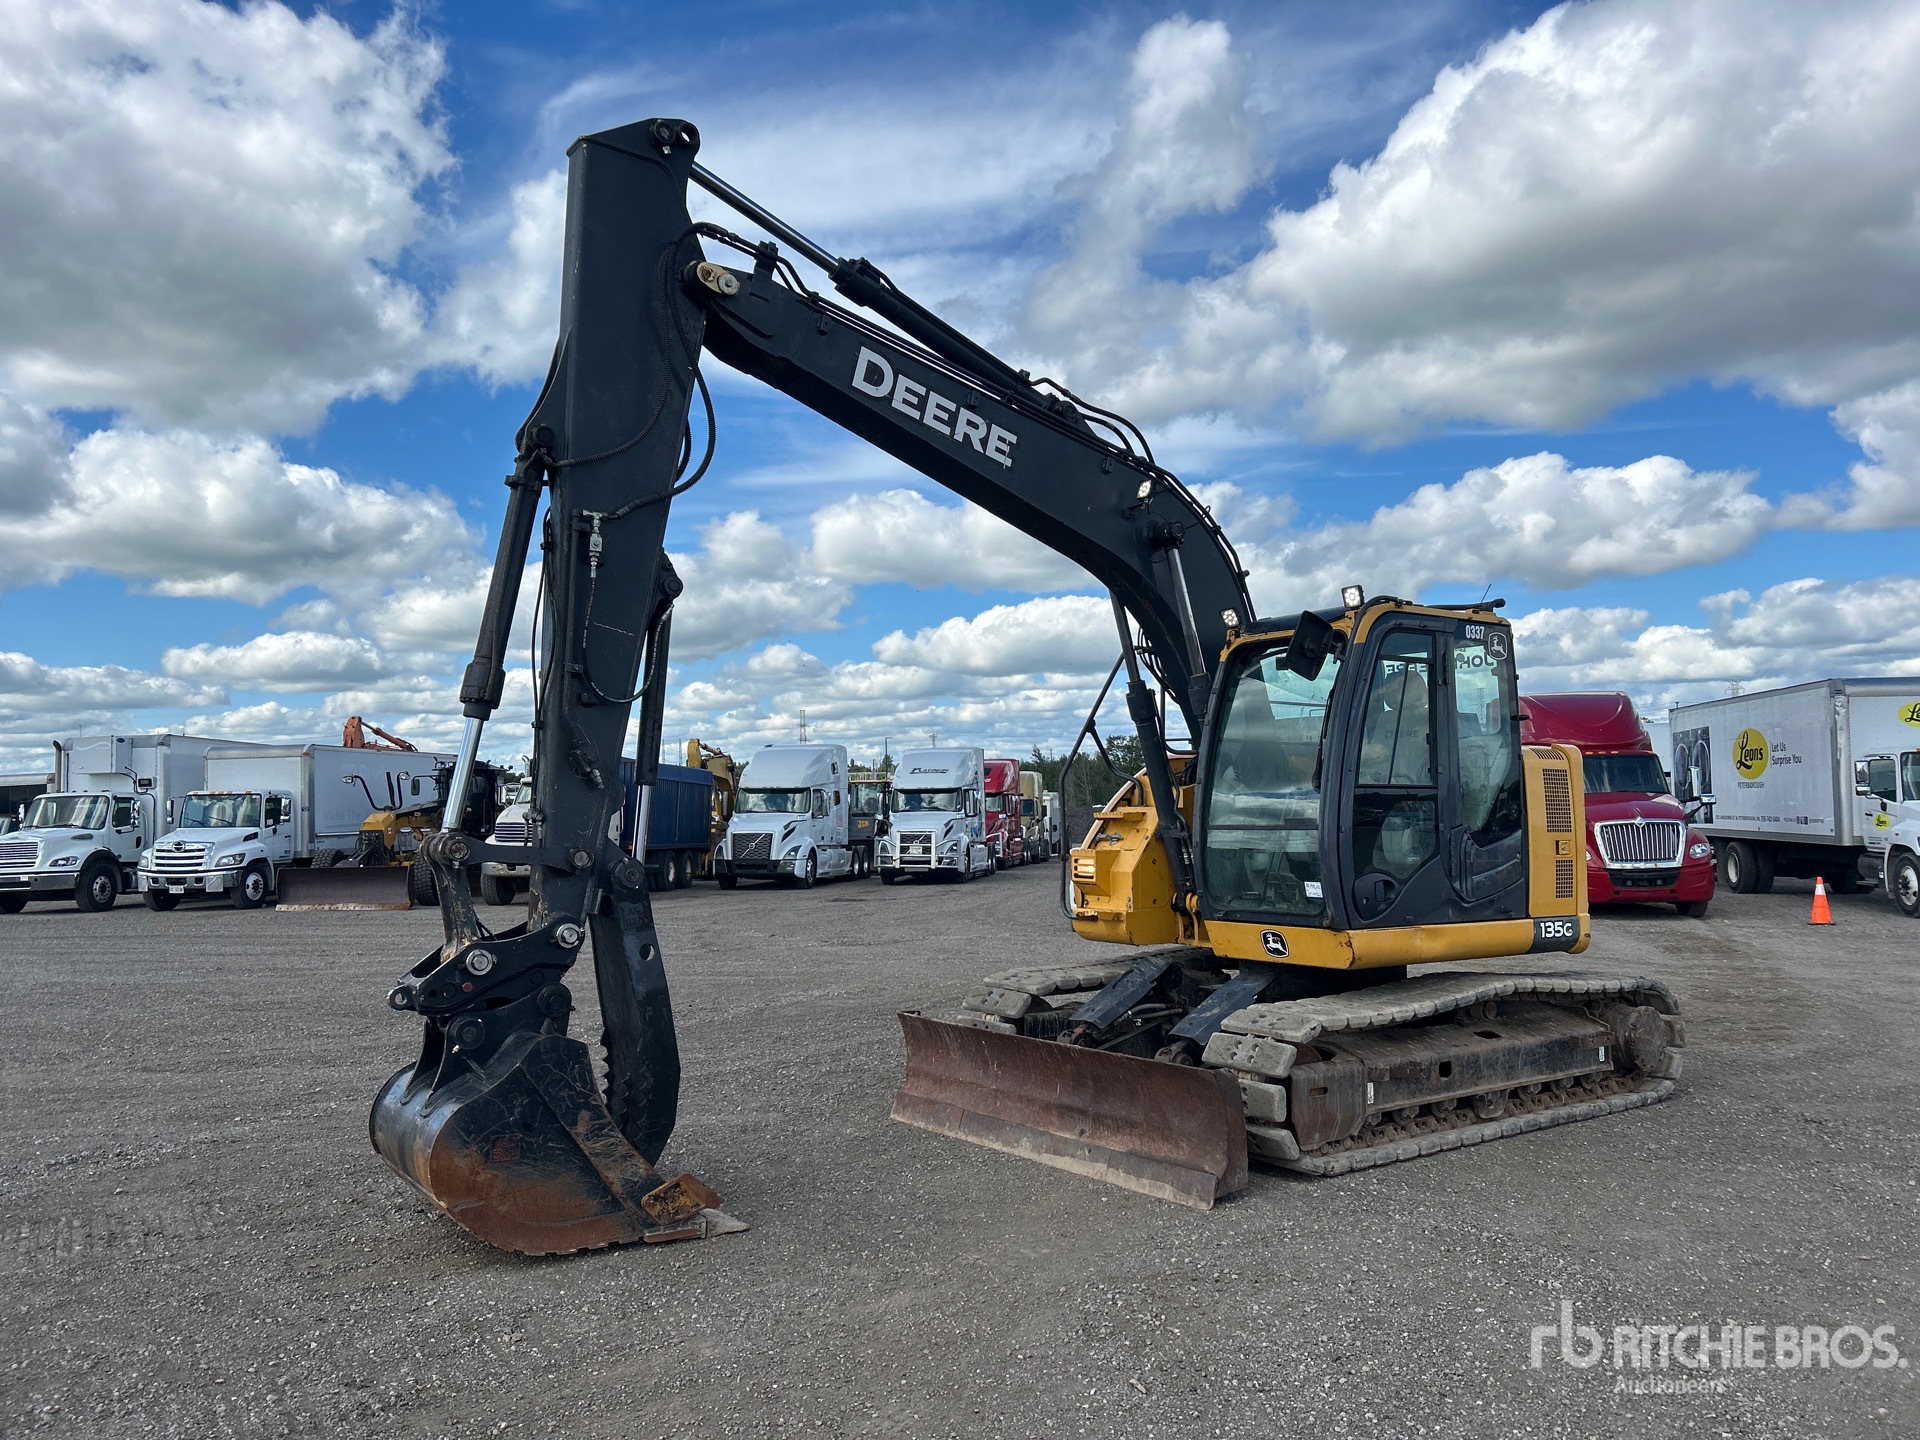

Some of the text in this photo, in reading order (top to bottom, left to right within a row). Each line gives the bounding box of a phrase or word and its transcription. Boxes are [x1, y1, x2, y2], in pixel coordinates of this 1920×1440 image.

[852, 345, 1018, 467] DEERE
[1465, 624, 1485, 640] 0337
[1904, 702, 1920, 723] Le
[1735, 730, 1764, 771] Leon's
[1771, 741, 1787, 752] Let Us
[1771, 754, 1802, 767] Surprise You
